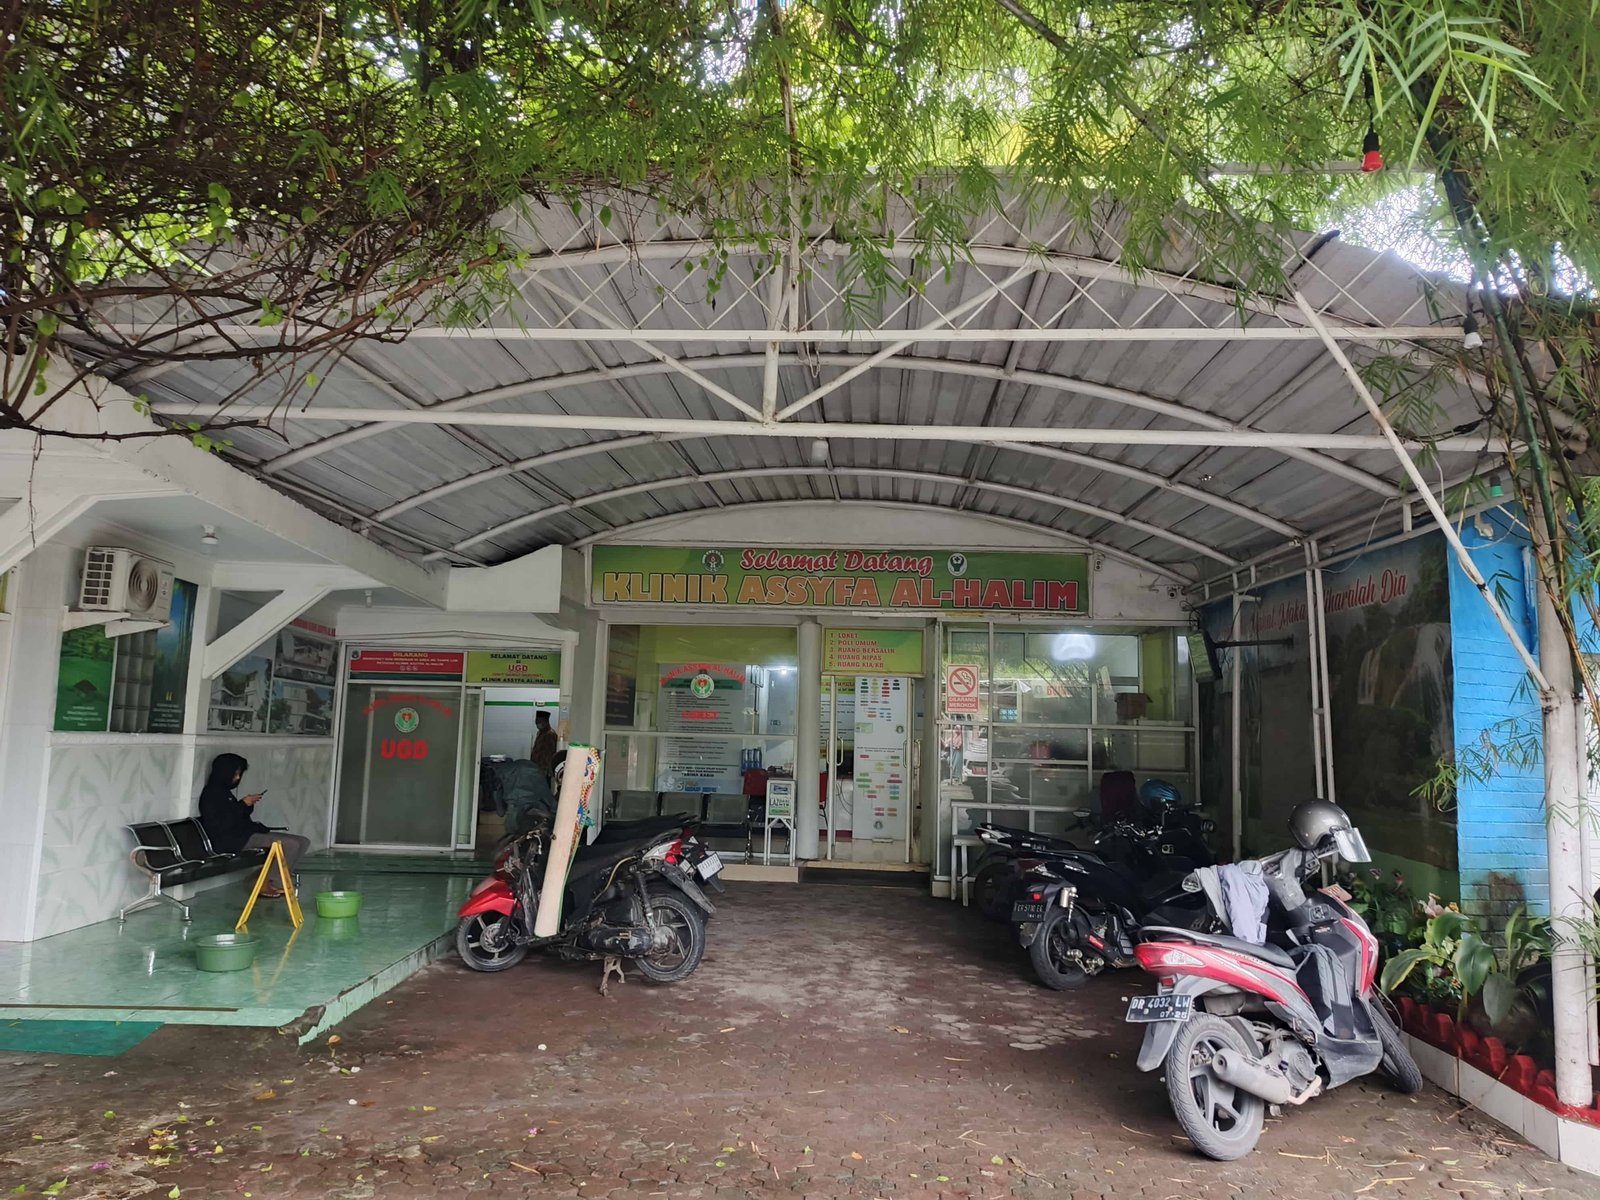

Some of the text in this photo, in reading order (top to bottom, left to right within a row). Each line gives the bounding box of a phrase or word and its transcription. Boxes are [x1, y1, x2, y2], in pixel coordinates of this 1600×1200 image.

[741, 549, 934, 576] Selamat Datang
[603, 573, 1080, 611] KLINIK ASSYFA AL-HALIM
[1279, 599, 1307, 630] Maka
[1381, 567, 1409, 605] Dia
[508, 664, 529, 672] UGD
[381, 739, 427, 760] UGD
[1131, 996, 1191, 1010] DR 4032 LW
